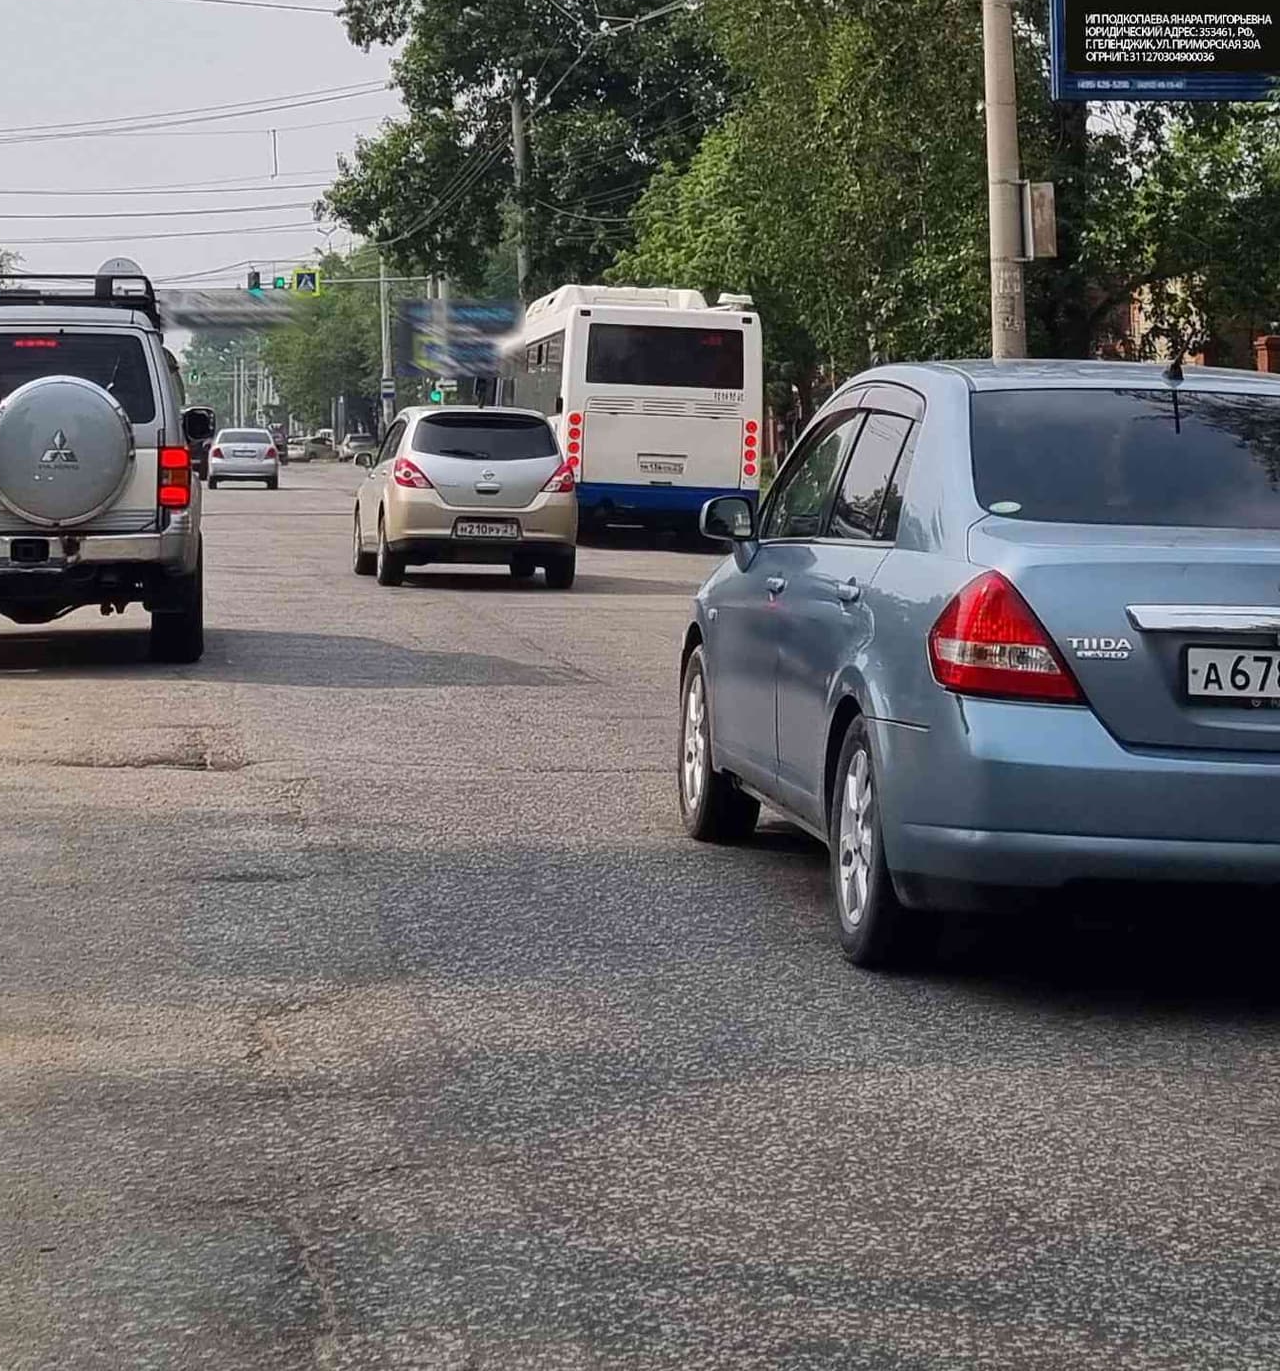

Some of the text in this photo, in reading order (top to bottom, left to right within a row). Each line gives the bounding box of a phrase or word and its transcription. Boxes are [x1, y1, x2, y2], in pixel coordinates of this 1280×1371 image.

[1085, 14, 1272, 26] ИП ПОДКОПАЕВА ЯНАРА ГРИГОРЬЕВНА
[1085, 26, 1255, 38] ЮРИДИЧЕСКИЙ АДРЕС: 353461, РФ,
[1172, 39, 1241, 50] ПРИМОРСКАЯ
[1242, 40, 1261, 50] 30А
[1086, 52, 1215, 62] ОГРНИП: 311270304900036
[1066, 637, 1132, 650] TIIDA
